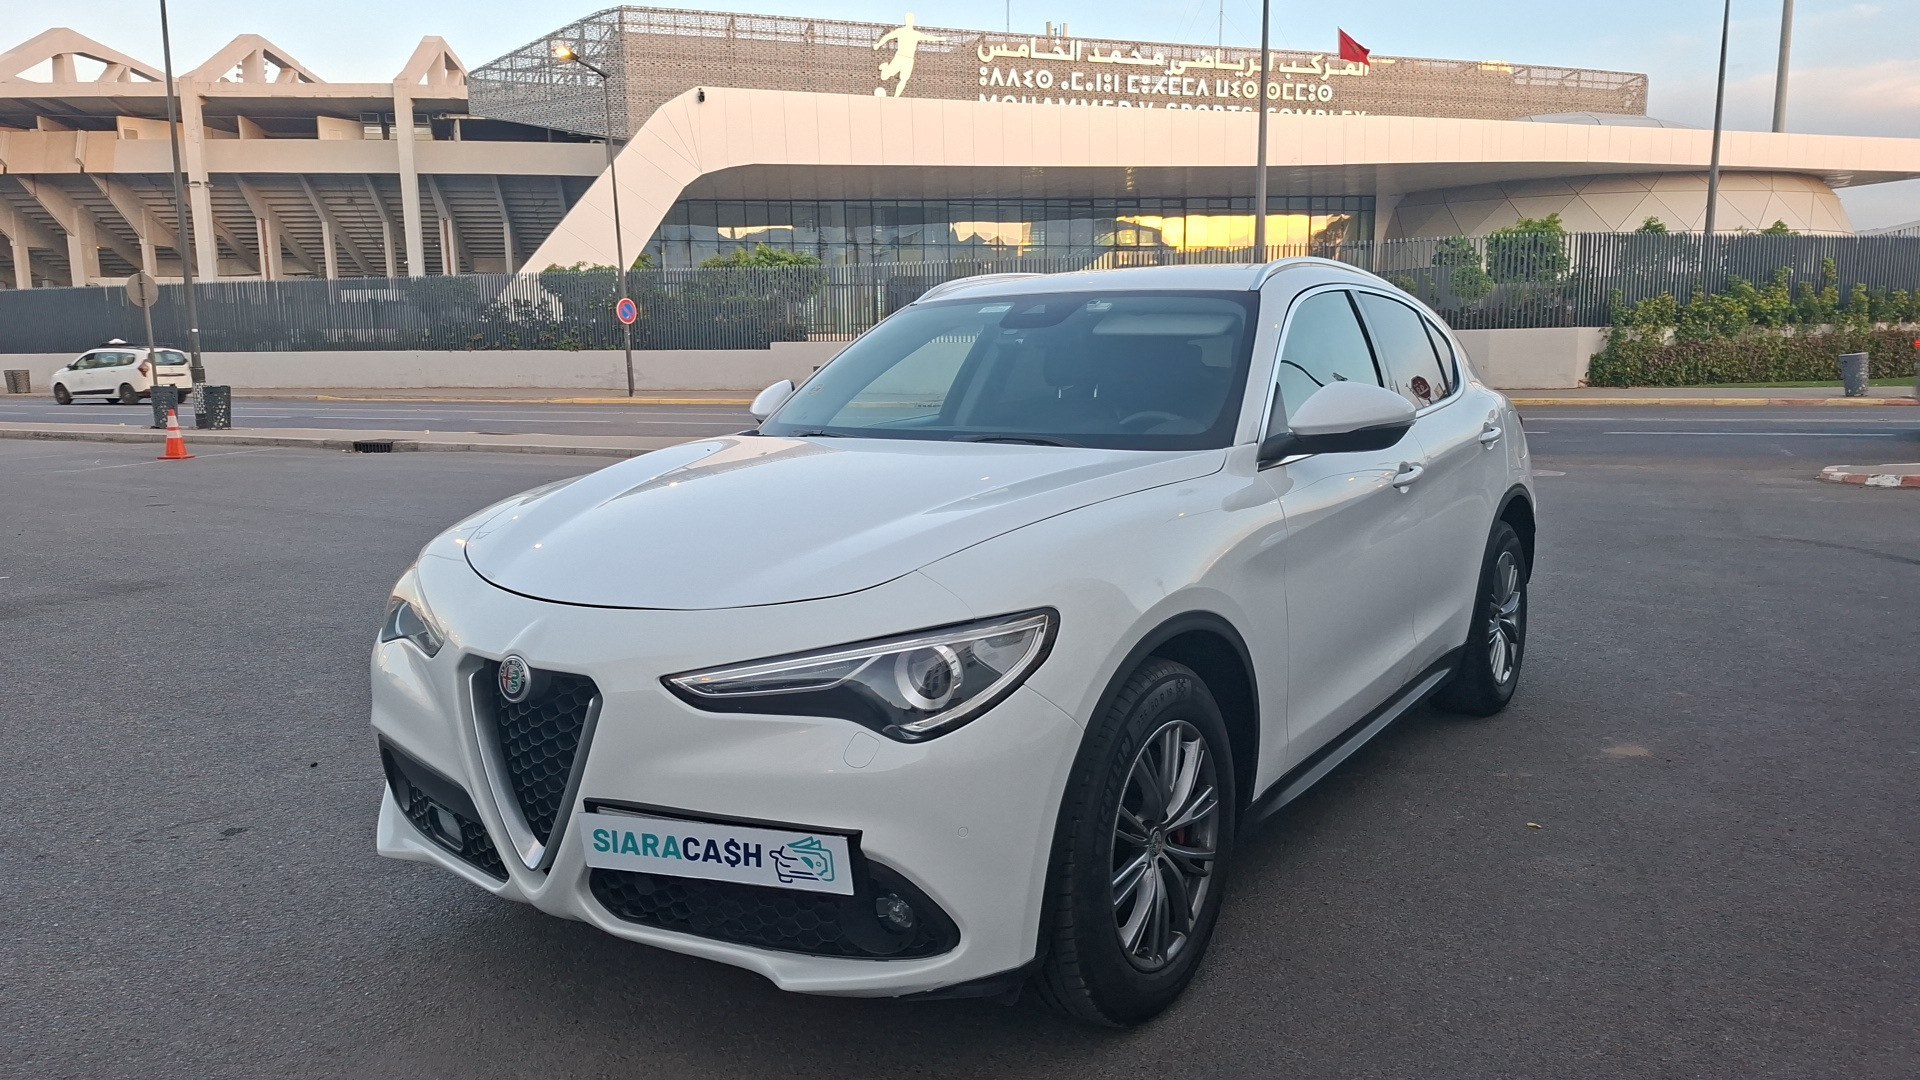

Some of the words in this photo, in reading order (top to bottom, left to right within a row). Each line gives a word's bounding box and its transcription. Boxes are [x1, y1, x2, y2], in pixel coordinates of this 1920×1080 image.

[976, 37, 1082, 63] الخامس
[1088, 46, 1164, 66] محمد
[592, 827, 762, 868] SIARACA$H
